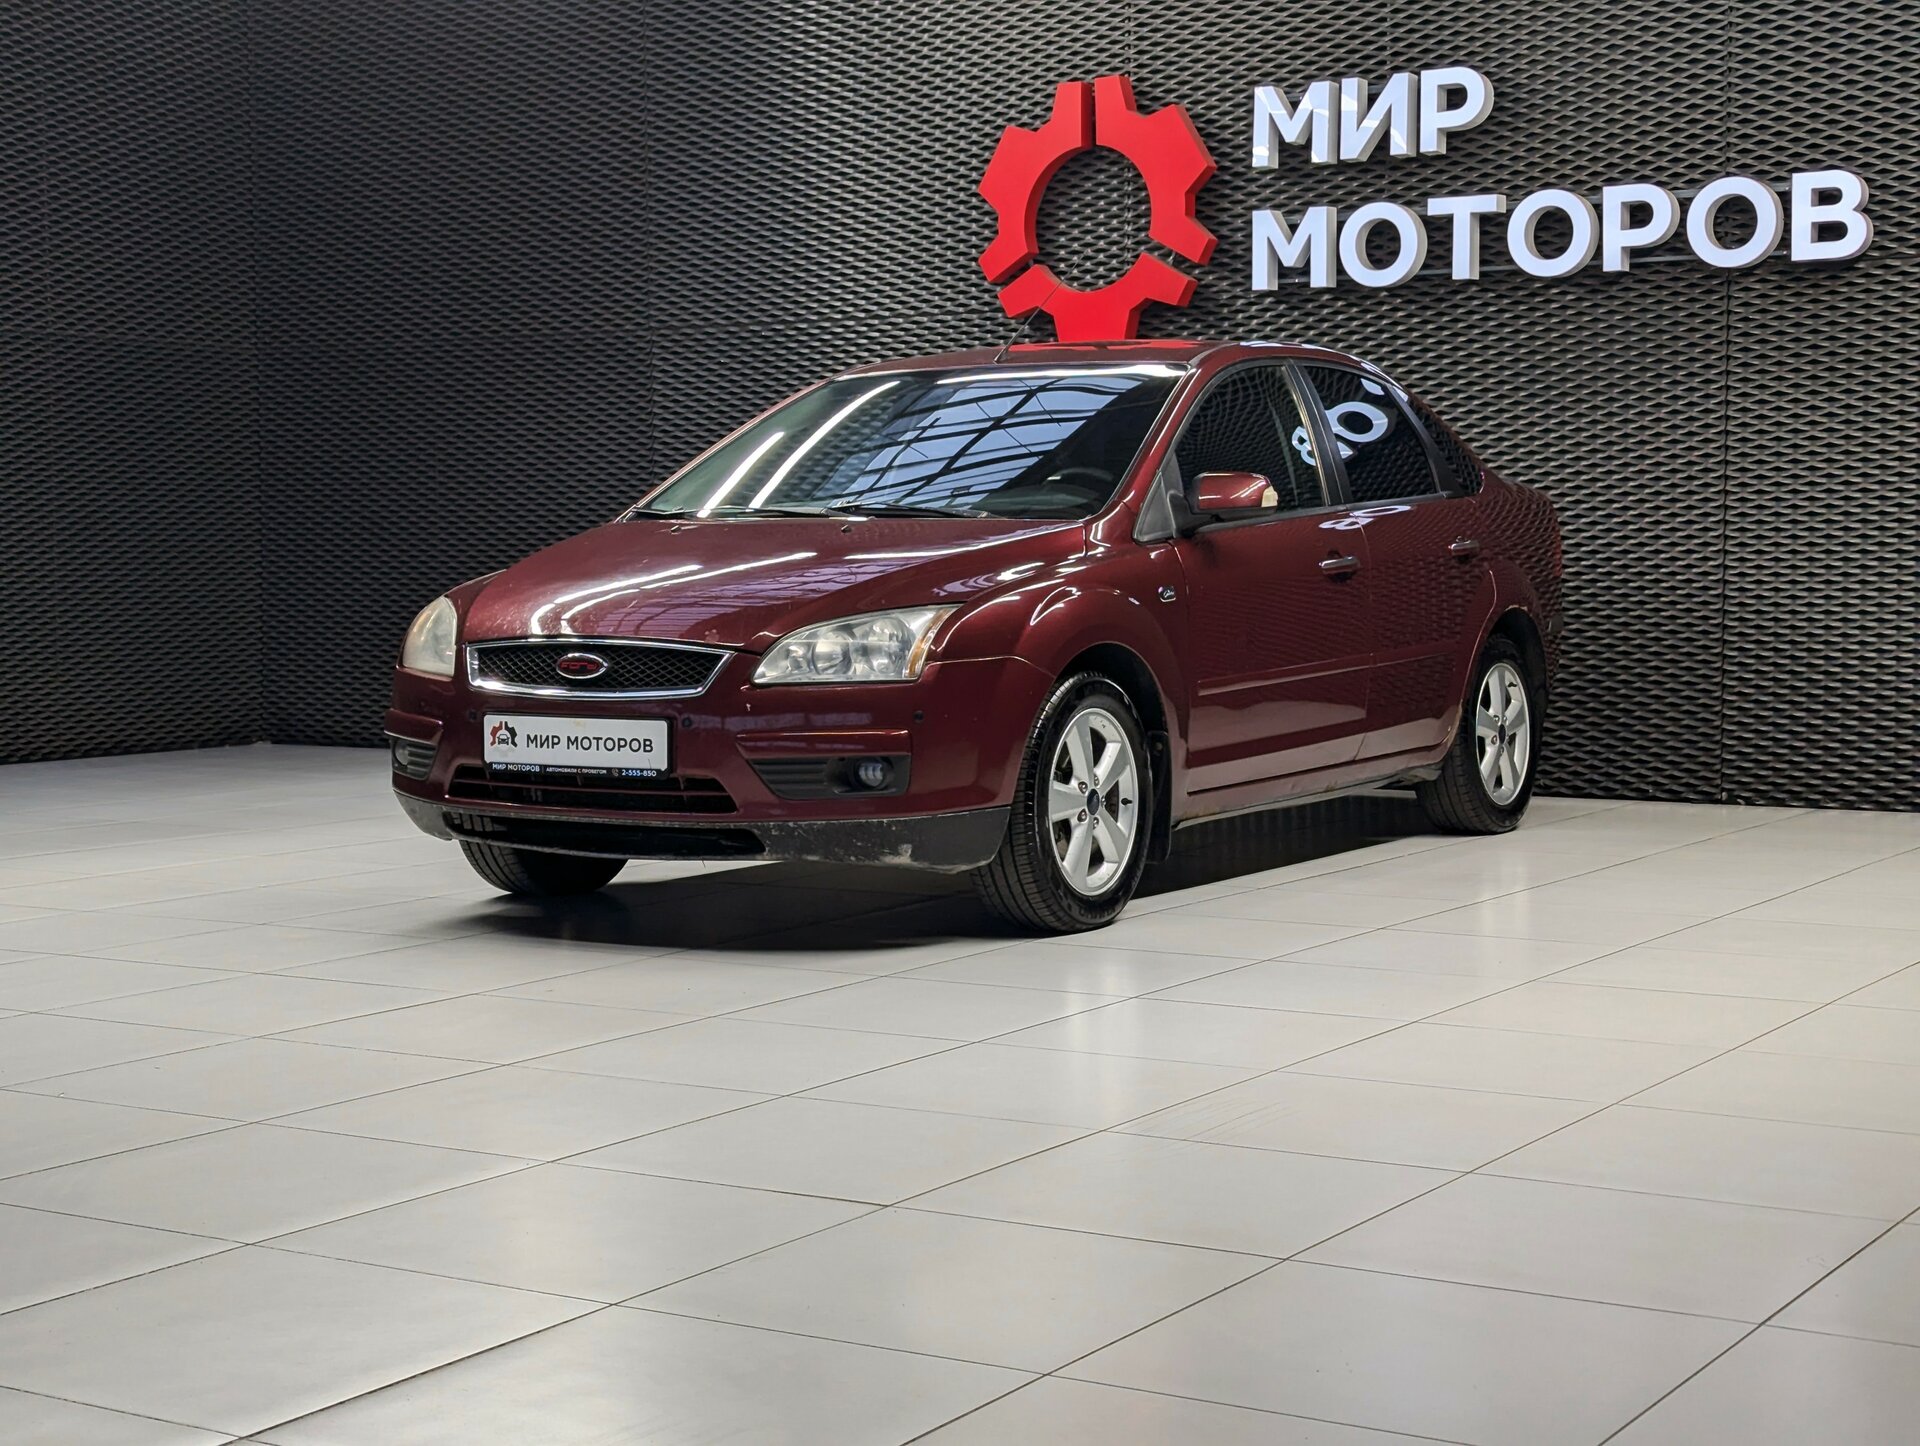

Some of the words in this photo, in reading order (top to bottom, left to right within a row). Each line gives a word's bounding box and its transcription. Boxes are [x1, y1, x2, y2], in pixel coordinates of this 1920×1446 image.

[1251, 65, 1494, 169] МИР
[1251, 169, 1874, 292] МОТОРОВ
[492, 763, 507, 771] МИР
[507, 764, 540, 772] МОТОРОВ
[621, 769, 657, 777] 2-555-850
[526, 734, 561, 750] МИР
[566, 736, 654, 753] МОТОРОВ
